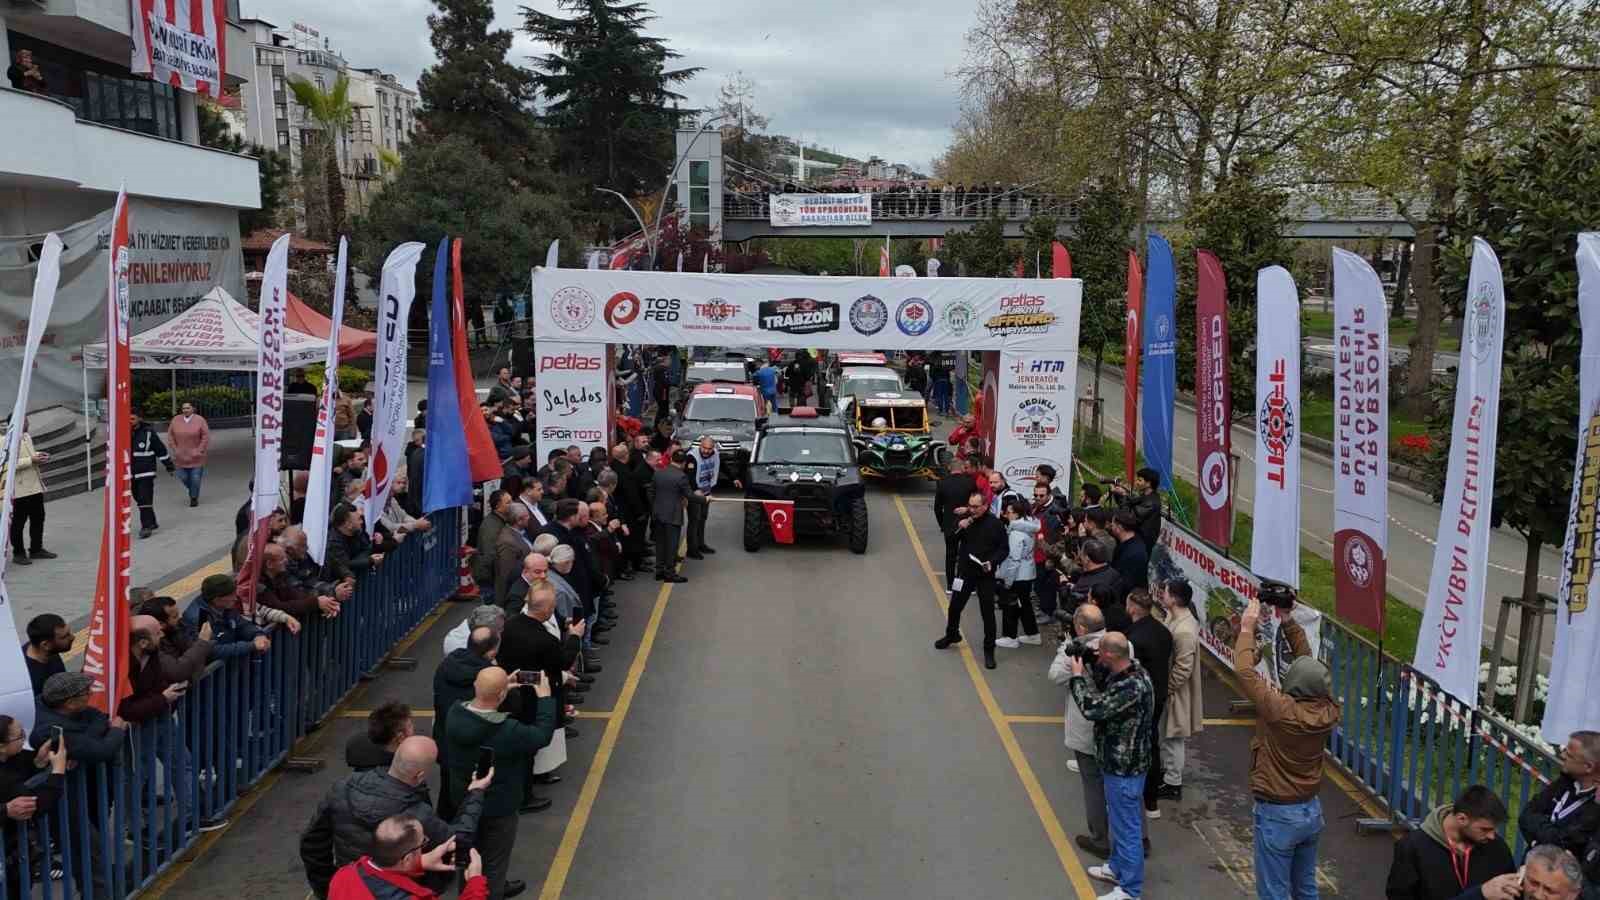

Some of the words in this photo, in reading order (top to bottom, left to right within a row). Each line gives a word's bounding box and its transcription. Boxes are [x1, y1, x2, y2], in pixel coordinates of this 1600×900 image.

[644, 297, 681, 310] TOS
[1000, 292, 1046, 310] petlas
[644, 310, 680, 322] FED
[763, 306, 834, 329] TRABZON
[539, 353, 601, 373] petlas
[261, 308, 275, 449] TRABZON
[543, 386, 602, 412] Salados
